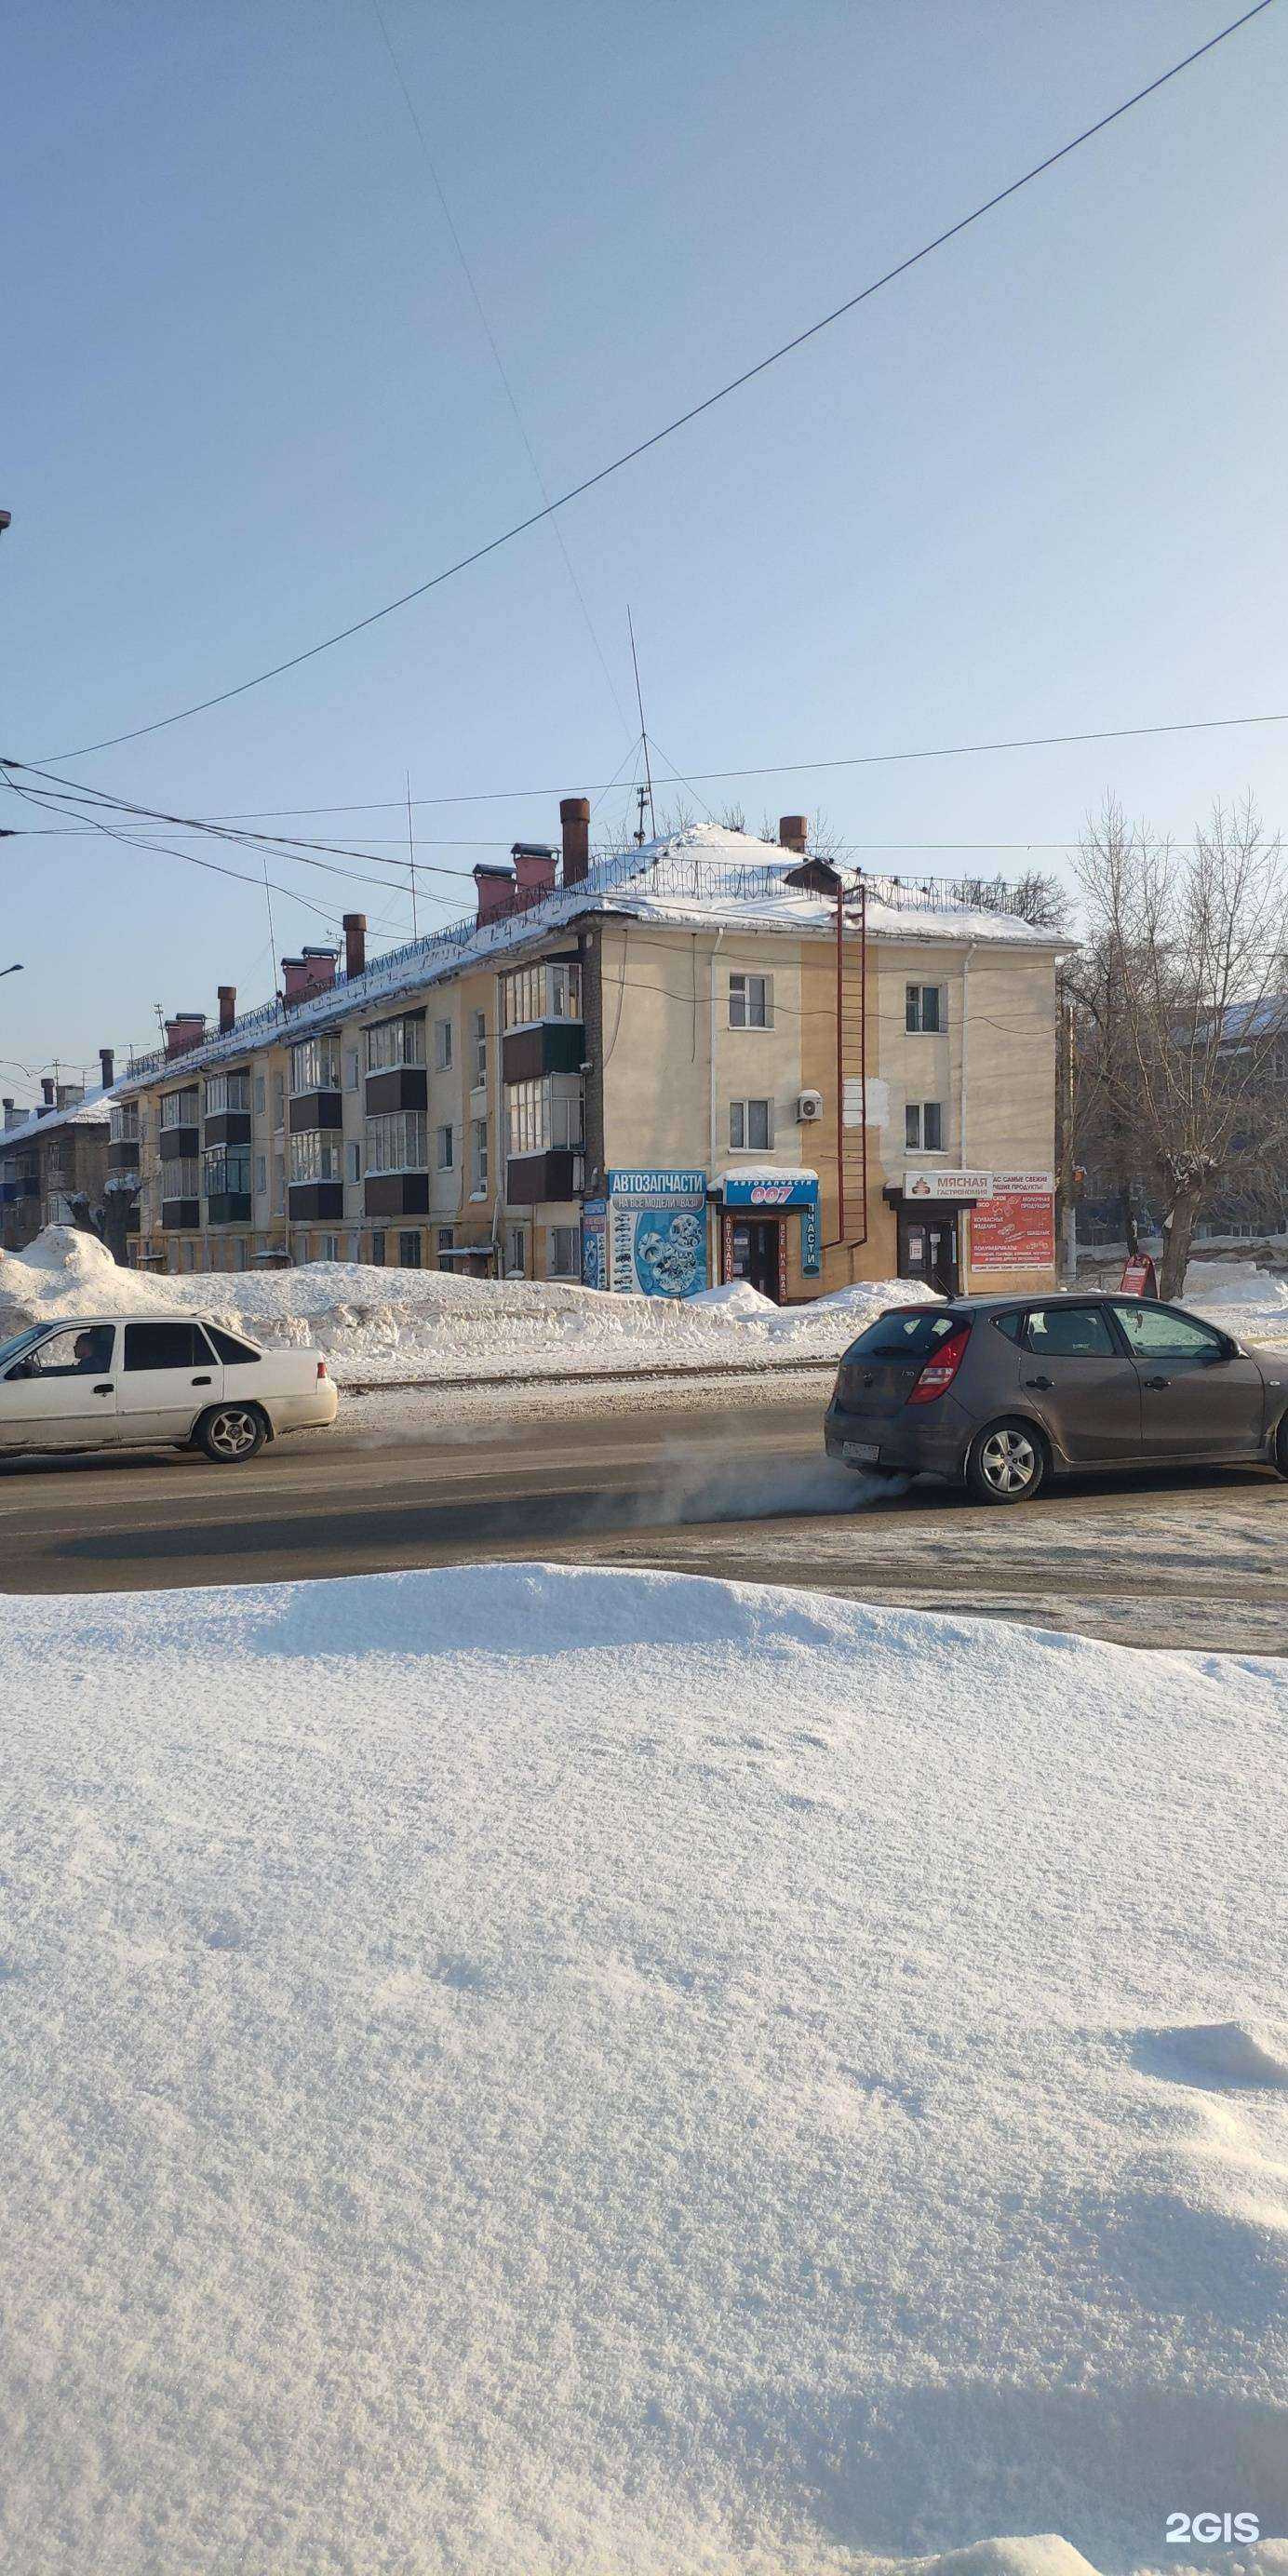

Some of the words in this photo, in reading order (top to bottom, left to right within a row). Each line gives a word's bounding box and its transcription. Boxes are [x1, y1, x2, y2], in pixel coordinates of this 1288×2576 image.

[612, 1174, 704, 1192] АВТОЗАПЧАСТИ
[937, 1177, 987, 1187] МЯСНАЯ
[750, 1186, 794, 1204] 007
[619, 1198, 629, 1208] НА
[630, 1198, 644, 1208] ВСЕ
[644, 1198, 676, 1209] МОДЕЛИ
[780, 1253, 786, 1267] НА
